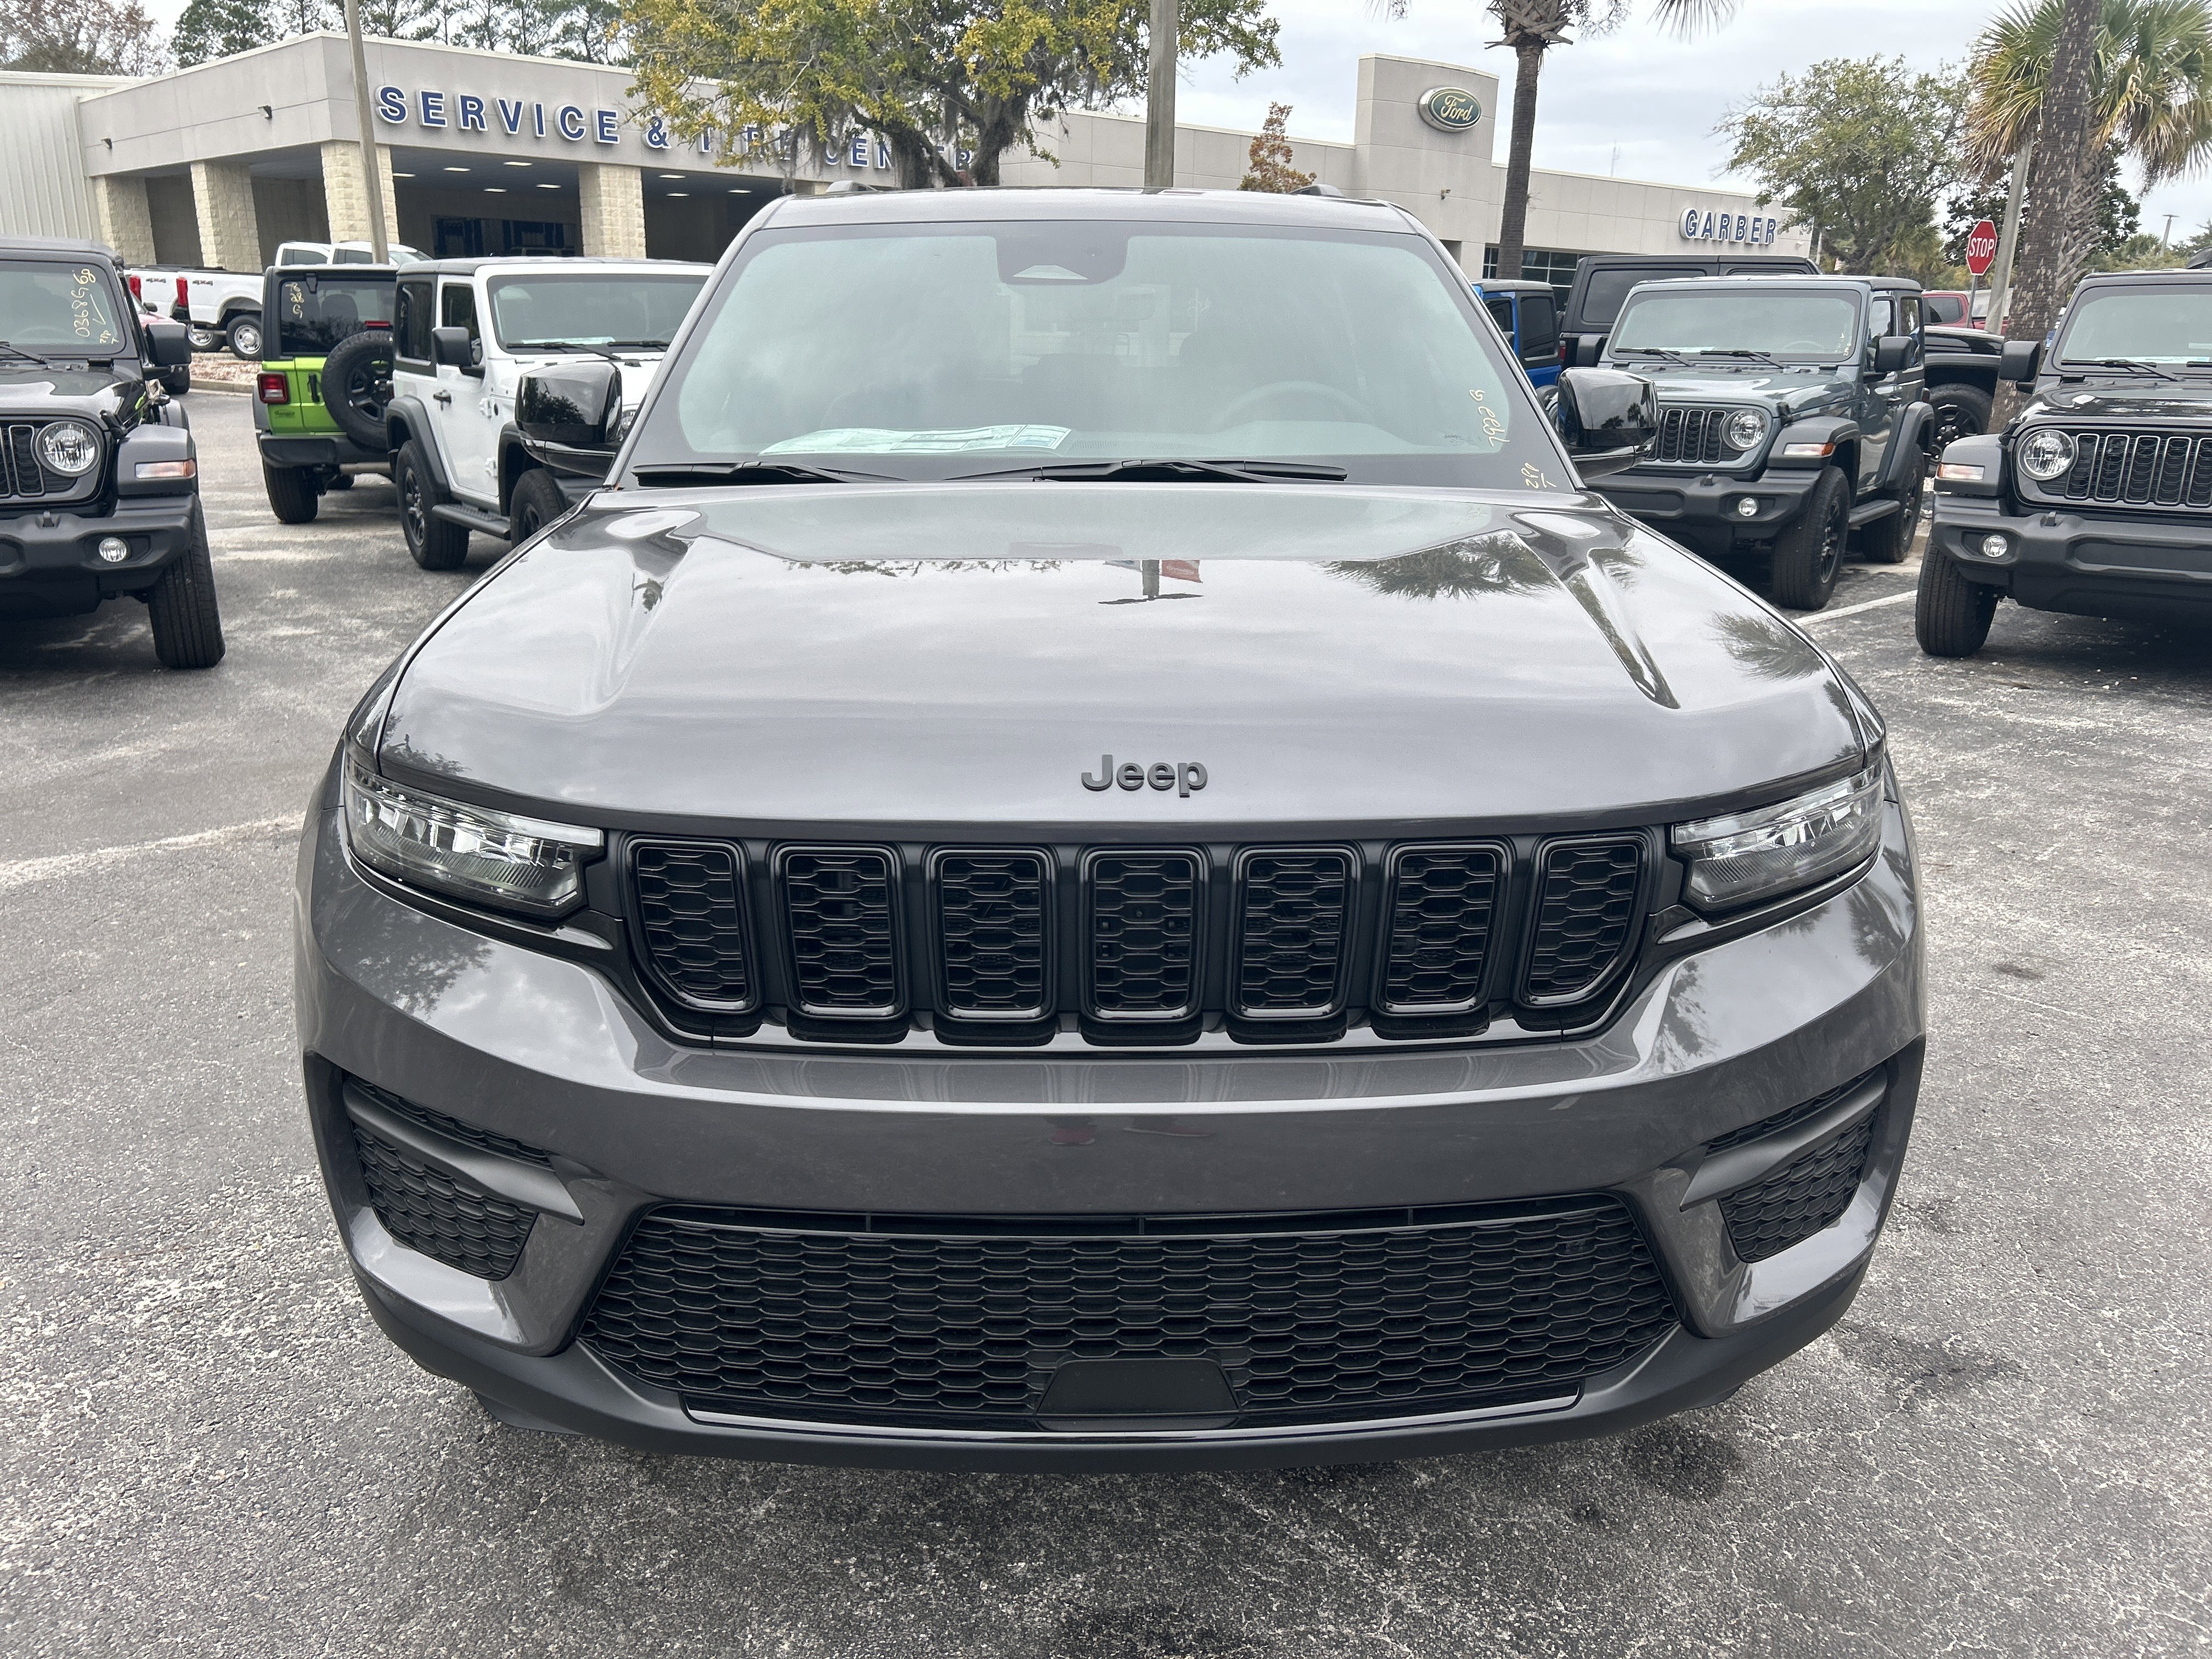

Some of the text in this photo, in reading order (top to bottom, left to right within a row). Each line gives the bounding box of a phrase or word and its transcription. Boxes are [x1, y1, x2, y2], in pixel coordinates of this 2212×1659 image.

[376, 85, 620, 144] SERVICE
[644, 114, 672, 149] &
[1440, 95, 1473, 121] Ford
[1681, 208, 1776, 245] GARBER
[1969, 237, 1995, 258] STOP
[1081, 754, 1207, 798] Jeep
